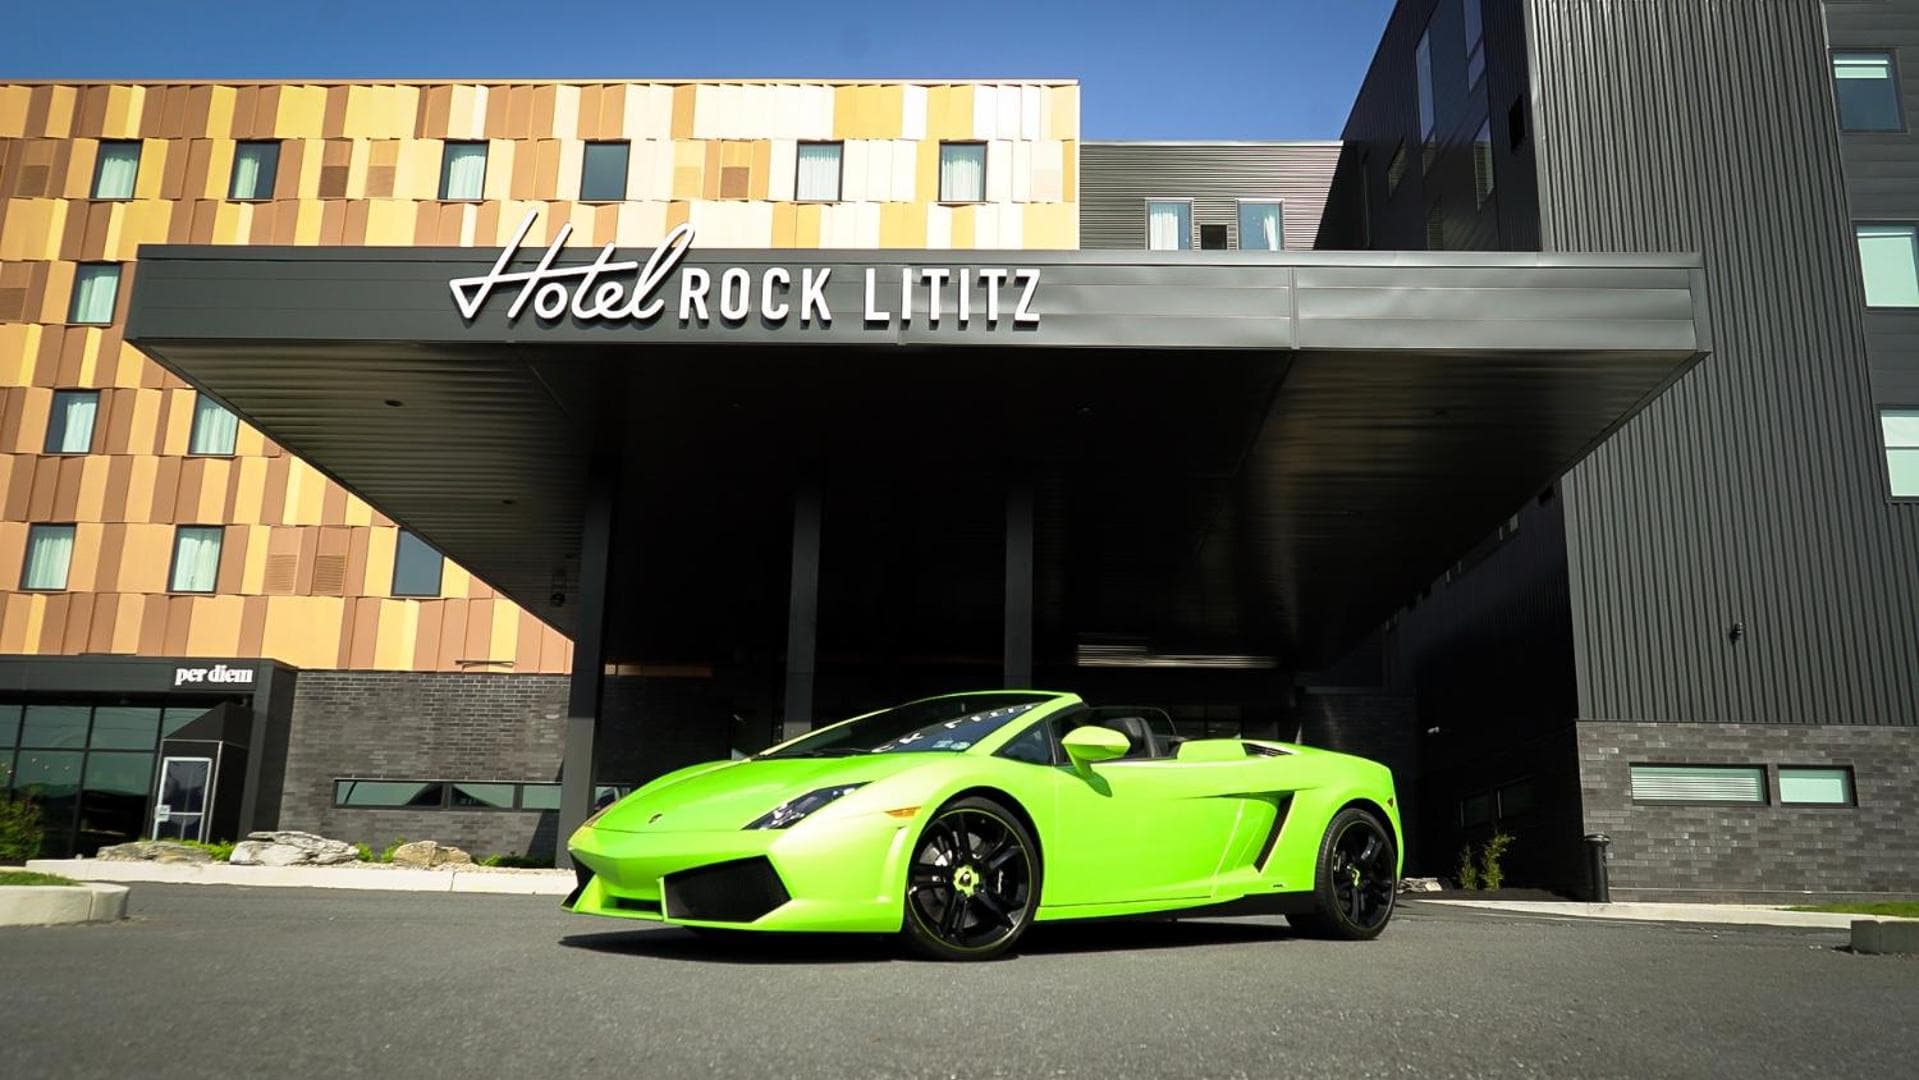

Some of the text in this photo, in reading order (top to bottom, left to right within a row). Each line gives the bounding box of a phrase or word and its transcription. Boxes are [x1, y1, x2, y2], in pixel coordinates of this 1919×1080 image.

[449, 208, 1041, 322] Hotel ROCK LITITZ
[174, 664, 254, 686] per diem
